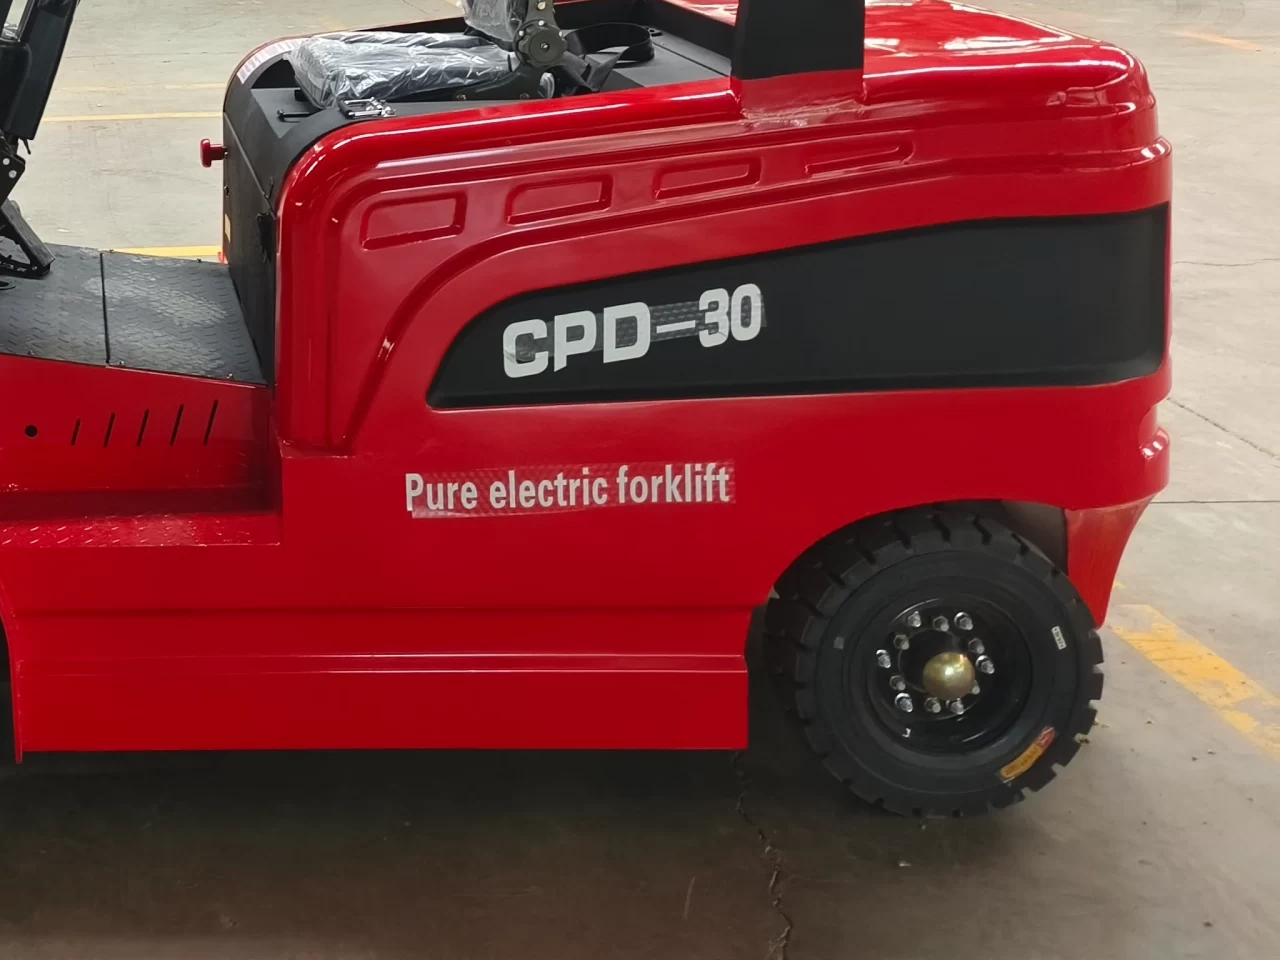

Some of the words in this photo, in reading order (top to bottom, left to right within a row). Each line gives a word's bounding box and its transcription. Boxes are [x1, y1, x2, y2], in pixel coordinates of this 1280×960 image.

[405, 472, 478, 511] Pure
[489, 468, 608, 509] electric
[618, 464, 730, 503] forklift
